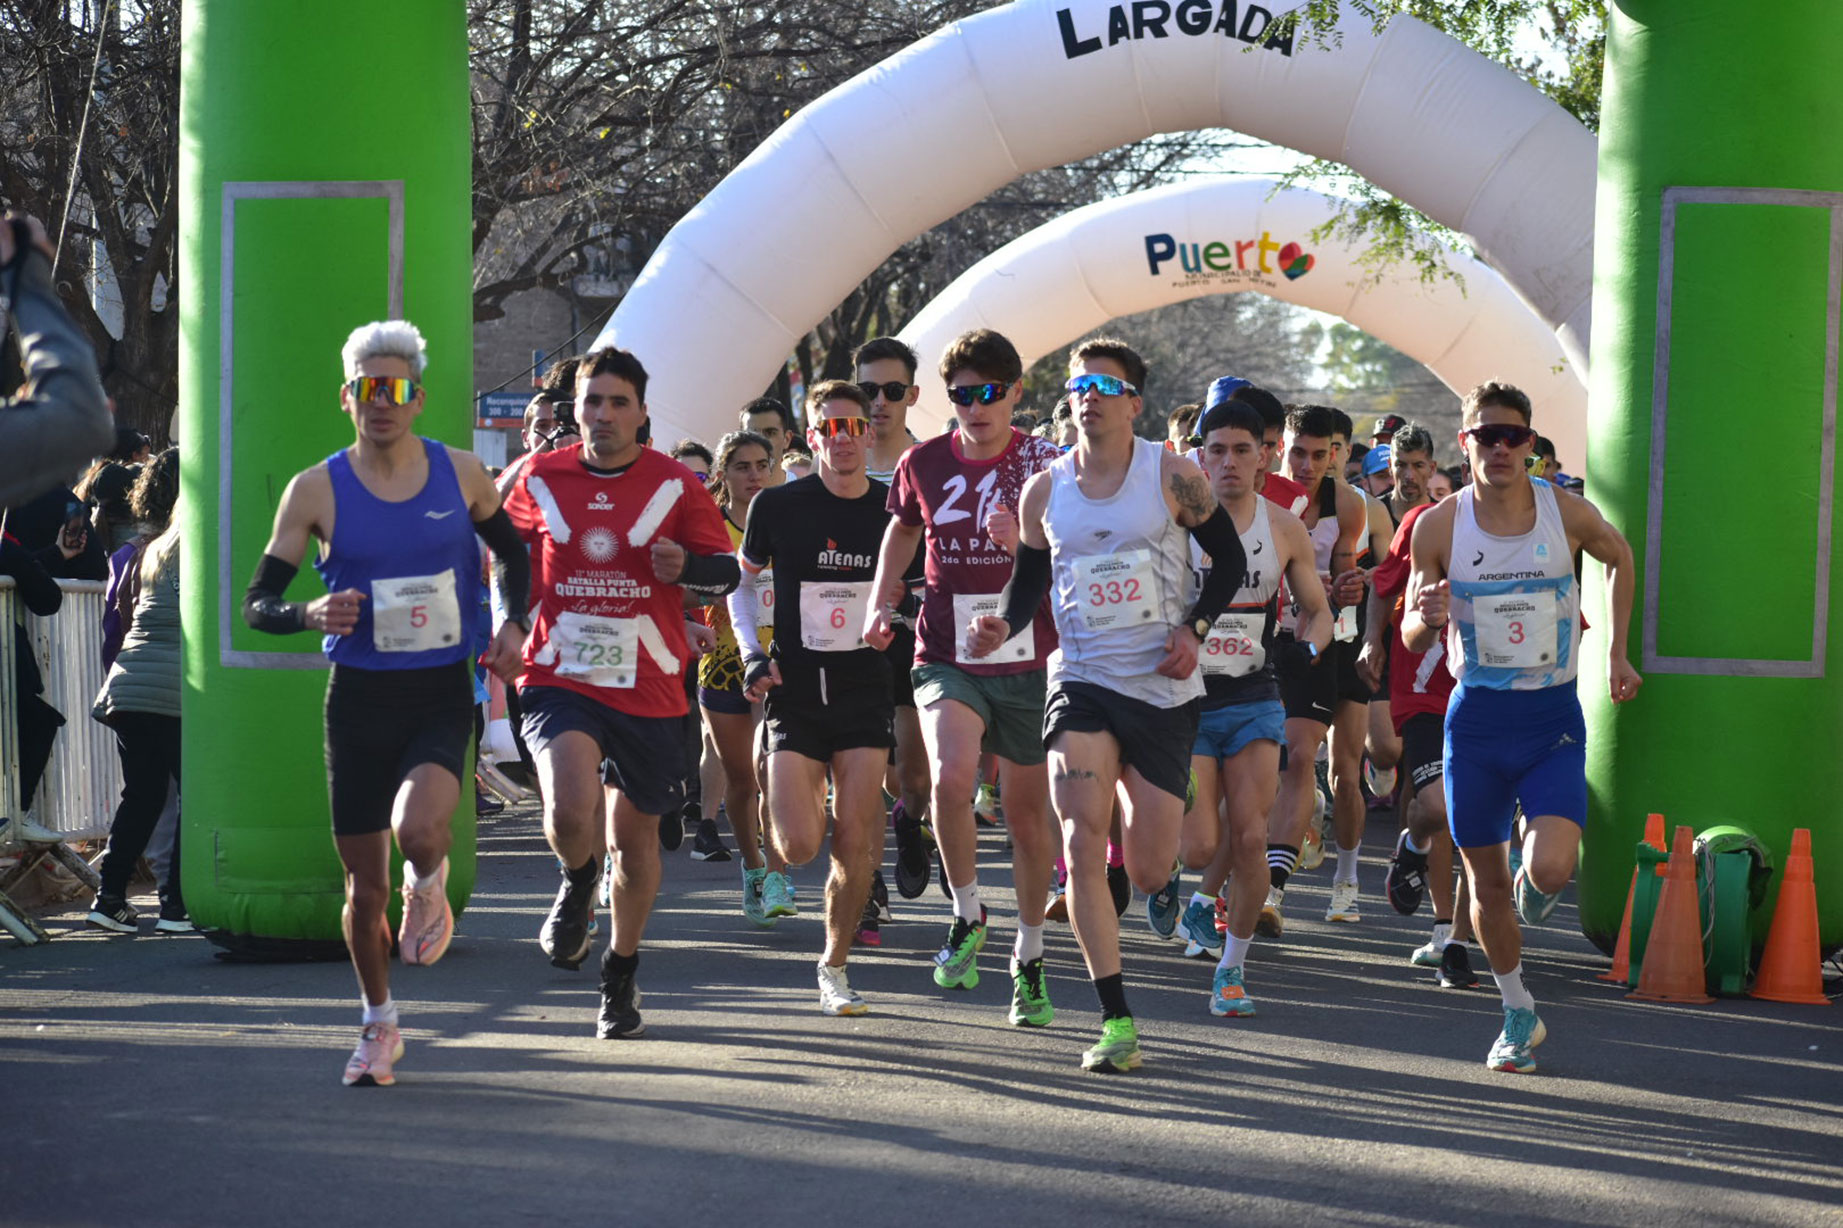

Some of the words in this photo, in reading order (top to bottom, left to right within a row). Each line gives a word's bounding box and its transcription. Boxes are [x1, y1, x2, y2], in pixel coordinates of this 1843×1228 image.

[1056, 0, 1297, 58] LARGADA
[818, 550, 871, 568] ATENAS
[966, 554, 1012, 565] EDICIÓN
[567, 576, 604, 586] BATALLA
[605, 578, 638, 587] PUNTA
[587, 570, 627, 579] MARATÓN
[1478, 570, 1545, 581] ARGENTINA
[555, 583, 651, 598] QUEBRACHO
[1088, 578, 1142, 607] 332
[410, 605, 429, 628] 5
[830, 607, 846, 629] 6
[1508, 621, 1525, 644] 3
[574, 641, 623, 667] 723
[1206, 637, 1254, 656] 362
